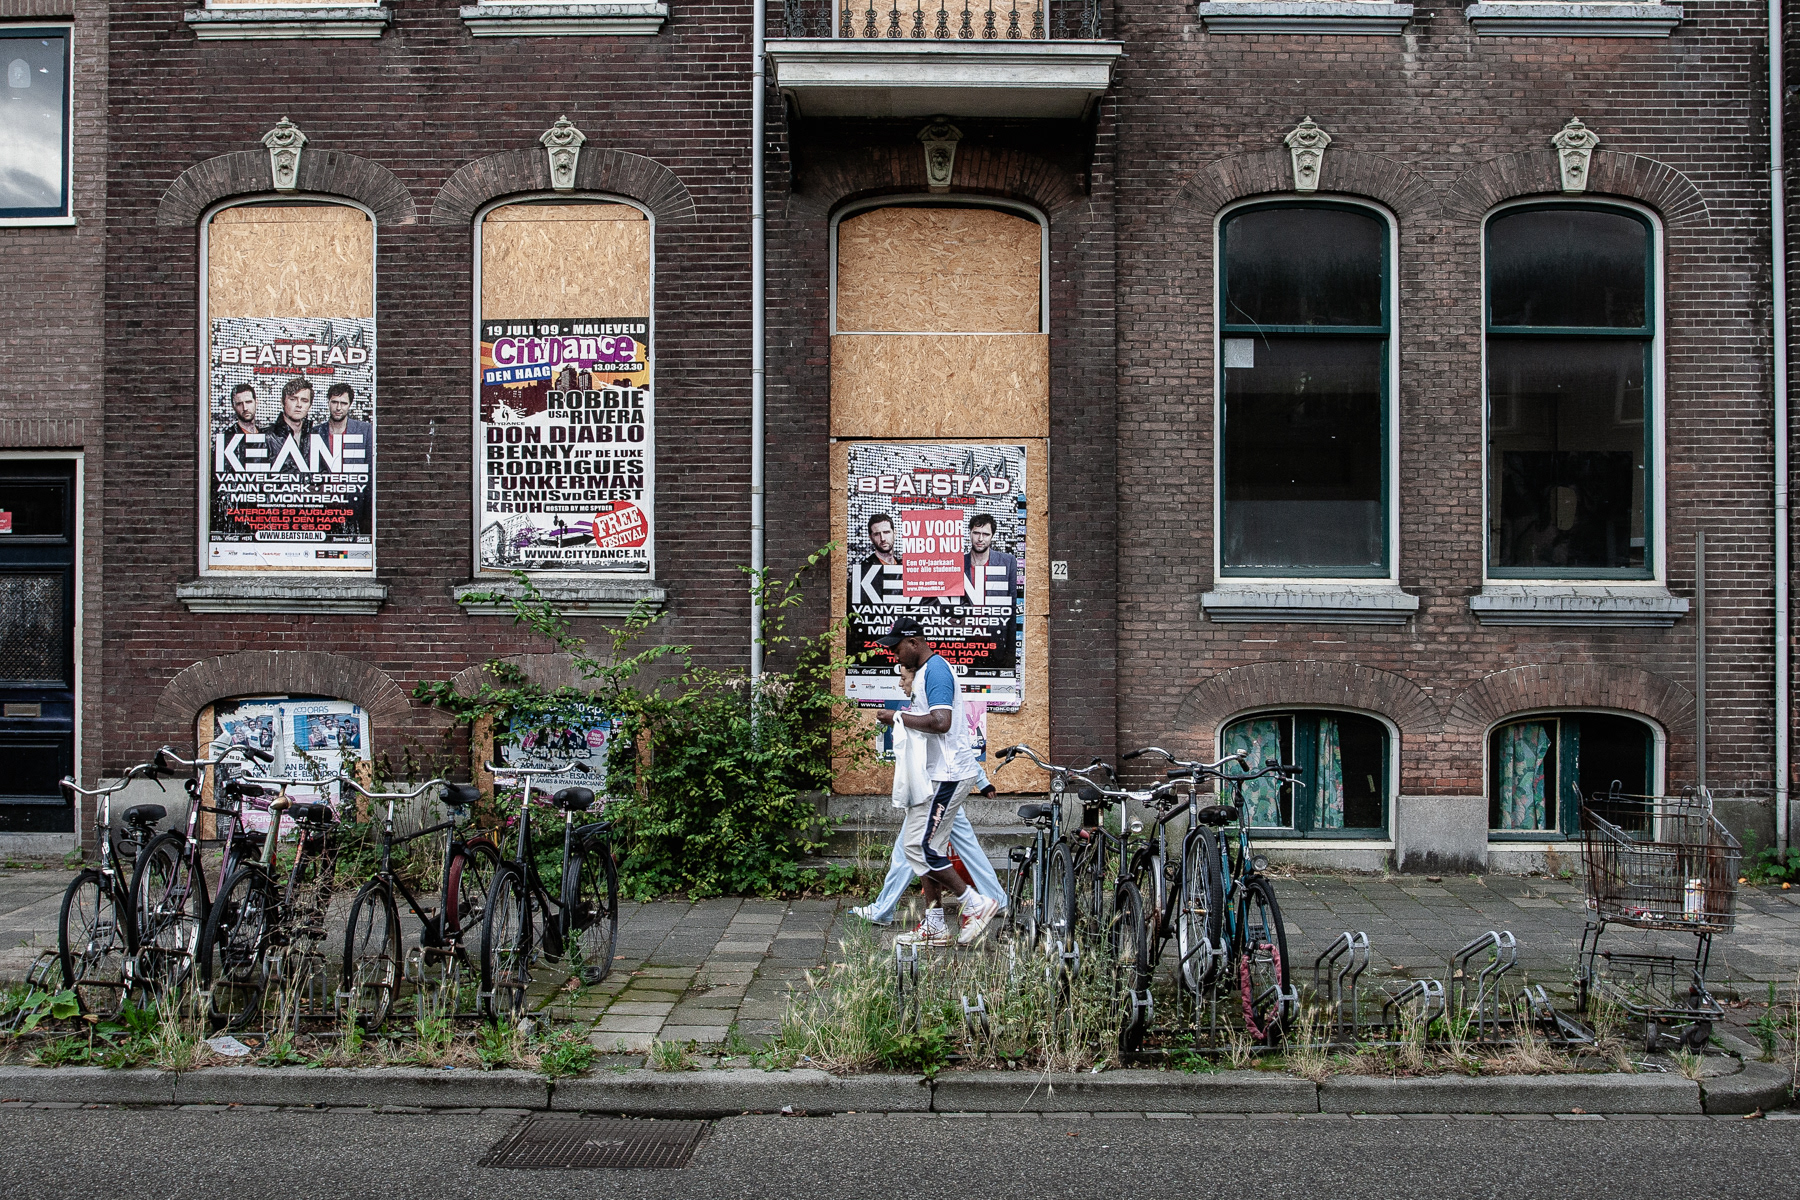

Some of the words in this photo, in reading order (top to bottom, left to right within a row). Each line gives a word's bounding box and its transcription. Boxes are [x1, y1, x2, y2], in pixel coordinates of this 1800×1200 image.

[486, 326, 503, 336] 19
[506, 325, 534, 335] JULI
[573, 323, 646, 335] MALIEVELD
[221, 344, 367, 366] BEATSTAD
[592, 363, 642, 371] 13.00-23.30
[486, 370, 514, 383] DEN
[515, 366, 551, 380] HAAG
[548, 391, 644, 409] ROBBIE
[548, 410, 569, 419] USA
[569, 409, 645, 424] RIVERA
[487, 426, 541, 444] DON
[549, 425, 644, 443] DIABLO
[215, 433, 369, 473] KEANE
[487, 445, 575, 460] BENNY
[574, 450, 592, 459] JIP
[595, 450, 611, 458] DE
[614, 450, 644, 458] LUXE
[487, 460, 644, 476] RODRIGUES
[215, 473, 300, 483] VANVELZEN
[312, 473, 369, 483] STEREO
[487, 475, 644, 490] FUNKERMAN
[217, 483, 260, 493] ALAIN
[262, 483, 311, 493] CLARK
[323, 484, 367, 493] RIGBY
[858, 474, 1010, 496] BEATSTAD
[230, 493, 266, 503] MISS
[269, 494, 349, 503] MONTREAL
[487, 489, 561, 501] DENNIS
[582, 489, 644, 501] GEEST
[227, 508, 280, 516] ZATERDAG
[282, 508, 298, 516] 29
[486, 501, 543, 513] KRUH
[595, 506, 642, 538] FREE
[902, 520, 921, 537] OV
[925, 519, 964, 536] VOOR
[259, 531, 323, 540] WWW.BEATSTAD.NL
[903, 537, 936, 553] MBO
[939, 537, 964, 553] NU!
[524, 549, 647, 559] WWW.CITYDANCE.NL
[1053, 563, 1068, 575] 22
[851, 565, 1013, 605] KENE
[852, 605, 941, 615] VANVELZEN
[953, 606, 1013, 615] STEREO
[964, 617, 1010, 626] RIGBY
[868, 626, 893, 636] MIS
[922, 627, 992, 637] ONTREAL
[307, 706, 329, 714] ORAS
[569, 773, 606, 781] ELSANDRO
